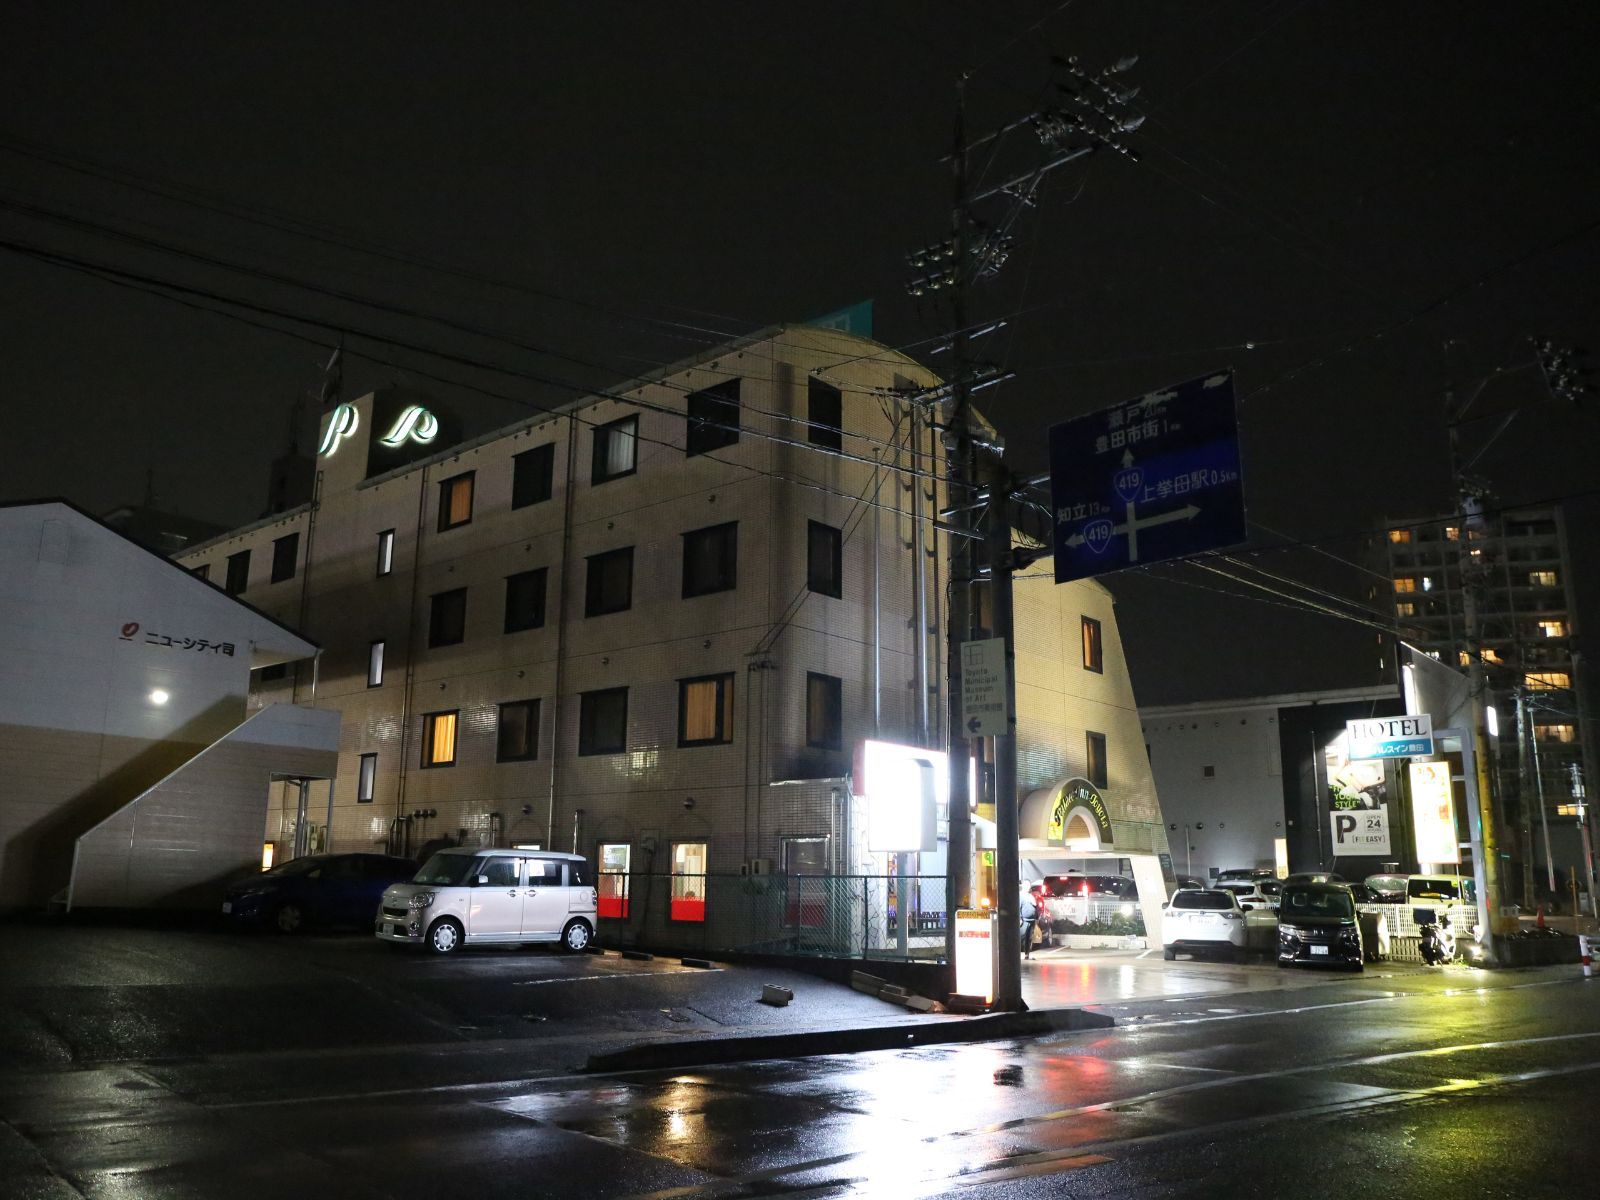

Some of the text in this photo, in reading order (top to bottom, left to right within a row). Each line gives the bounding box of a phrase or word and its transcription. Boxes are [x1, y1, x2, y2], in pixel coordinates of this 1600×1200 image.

[1095, 418, 1160, 455] 豊田市街
[1118, 472, 1140, 491] 419
[1057, 502, 1087, 526] 知立
[1088, 524, 1109, 542] 419
[144, 632, 235, 657] ニューシティ司
[965, 675, 998, 686] Municipal
[1352, 719, 1427, 739] HOTEL
[1335, 814, 1357, 844] P
[1366, 819, 1381, 829] 24
